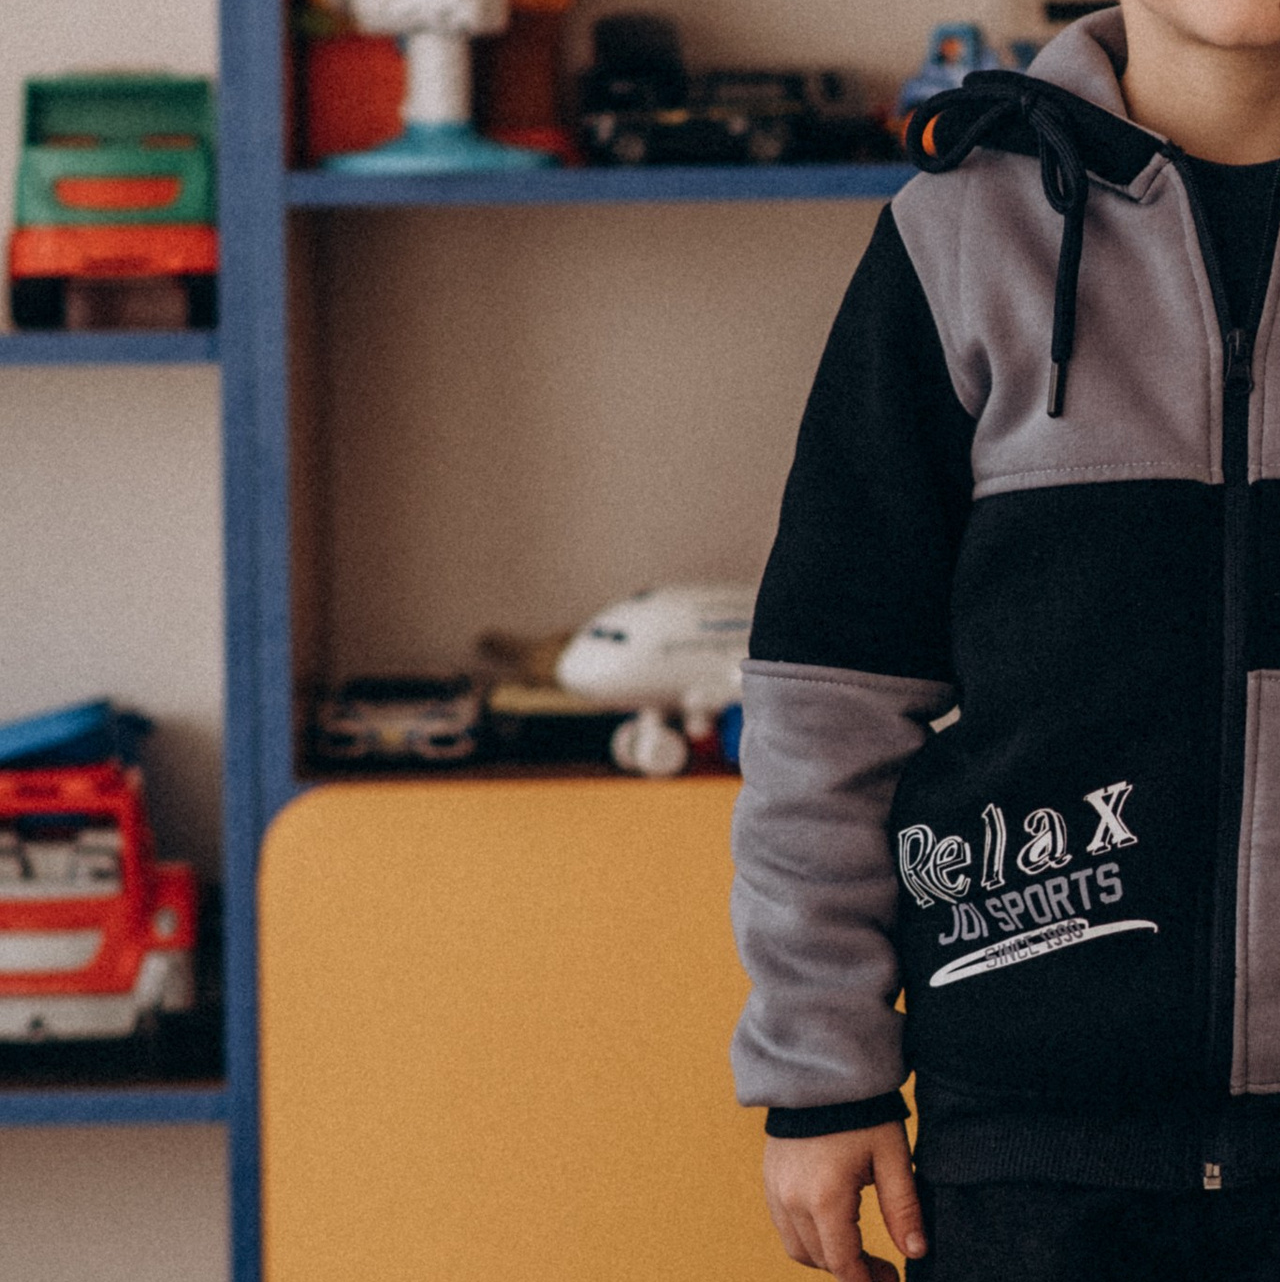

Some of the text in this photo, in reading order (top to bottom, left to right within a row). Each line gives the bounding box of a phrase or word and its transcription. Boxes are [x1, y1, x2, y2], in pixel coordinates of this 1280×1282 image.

[985, 862, 1123, 932] SPORTS
[984, 919, 1084, 969] SINCE 1990
